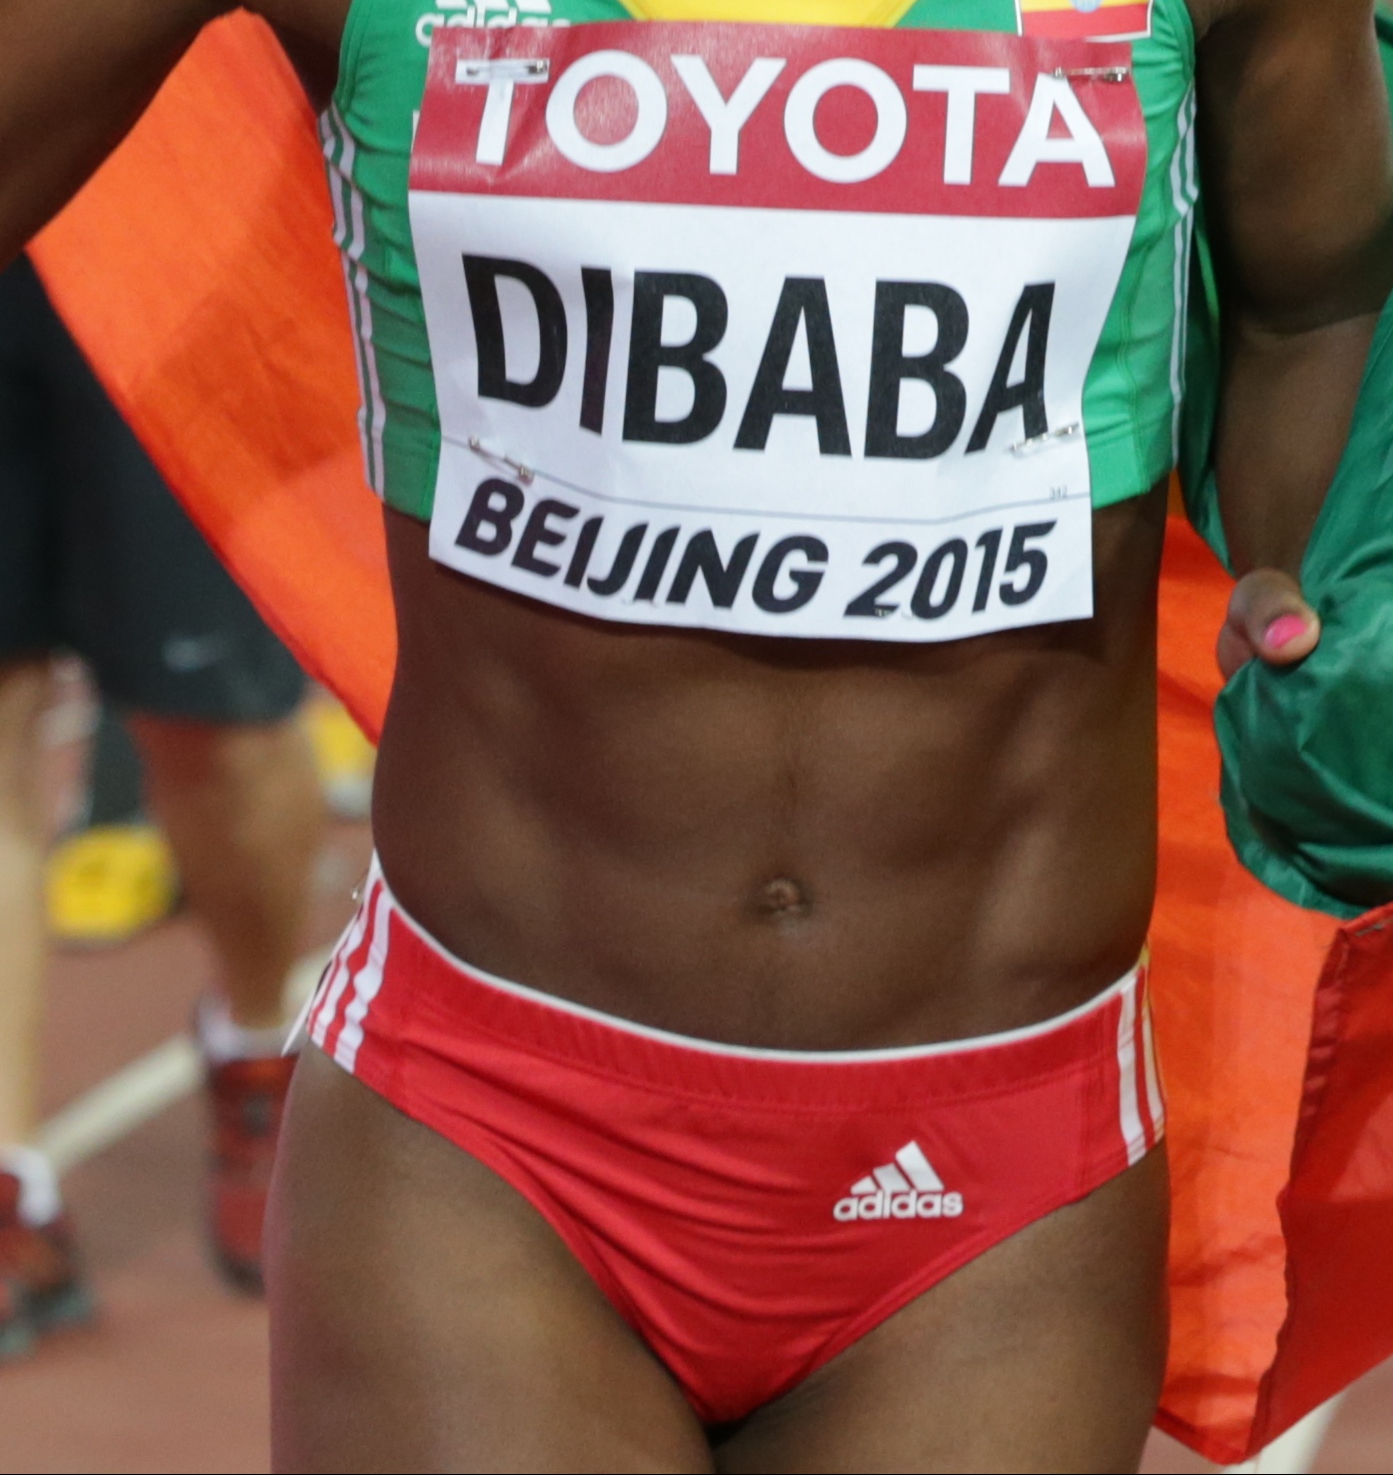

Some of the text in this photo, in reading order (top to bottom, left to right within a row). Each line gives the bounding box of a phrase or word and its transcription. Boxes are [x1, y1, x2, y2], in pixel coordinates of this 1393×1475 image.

[454, 50, 1116, 188] TOYOTA
[461, 253, 1056, 461] DIBABA
[454, 477, 1058, 620] BEIJING 2015
[833, 1189, 964, 1221] adidas
